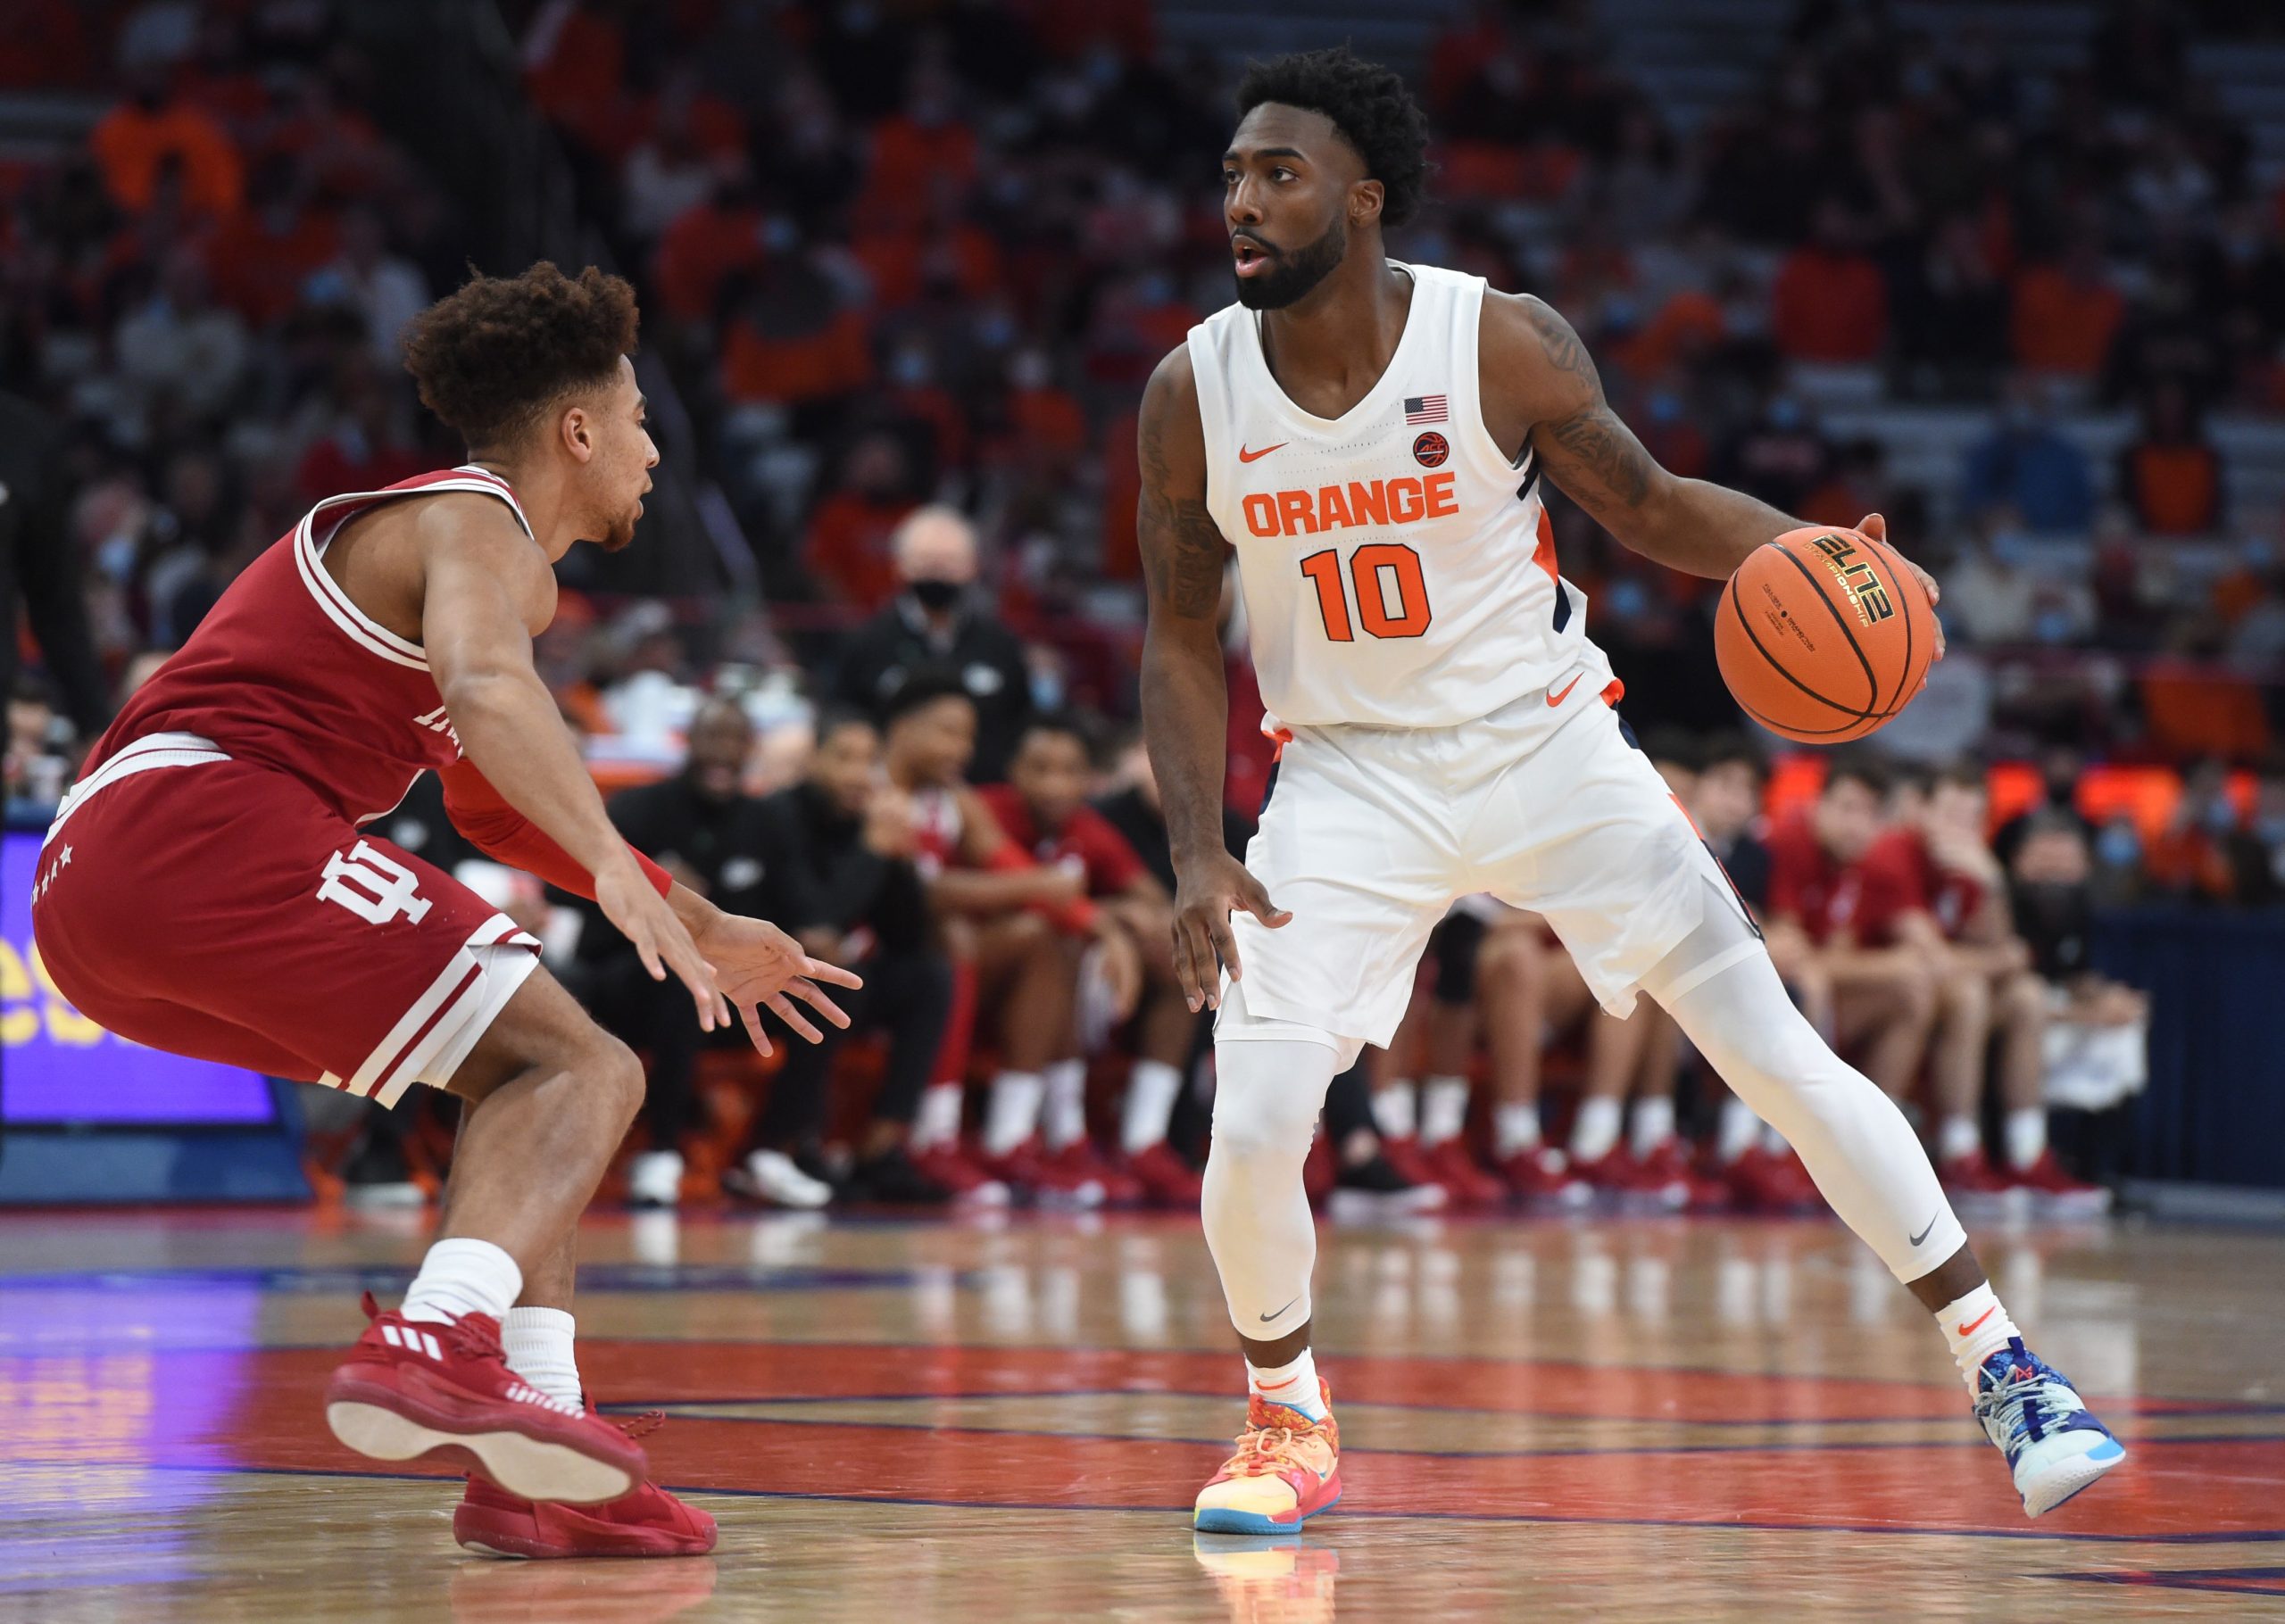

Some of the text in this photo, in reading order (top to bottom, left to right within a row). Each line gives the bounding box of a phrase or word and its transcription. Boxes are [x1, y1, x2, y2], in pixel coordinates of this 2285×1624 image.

[1242, 471, 1459, 537] ORANGE
[1300, 543, 1432, 642] 10
[1811, 533, 1896, 625] ELITE
